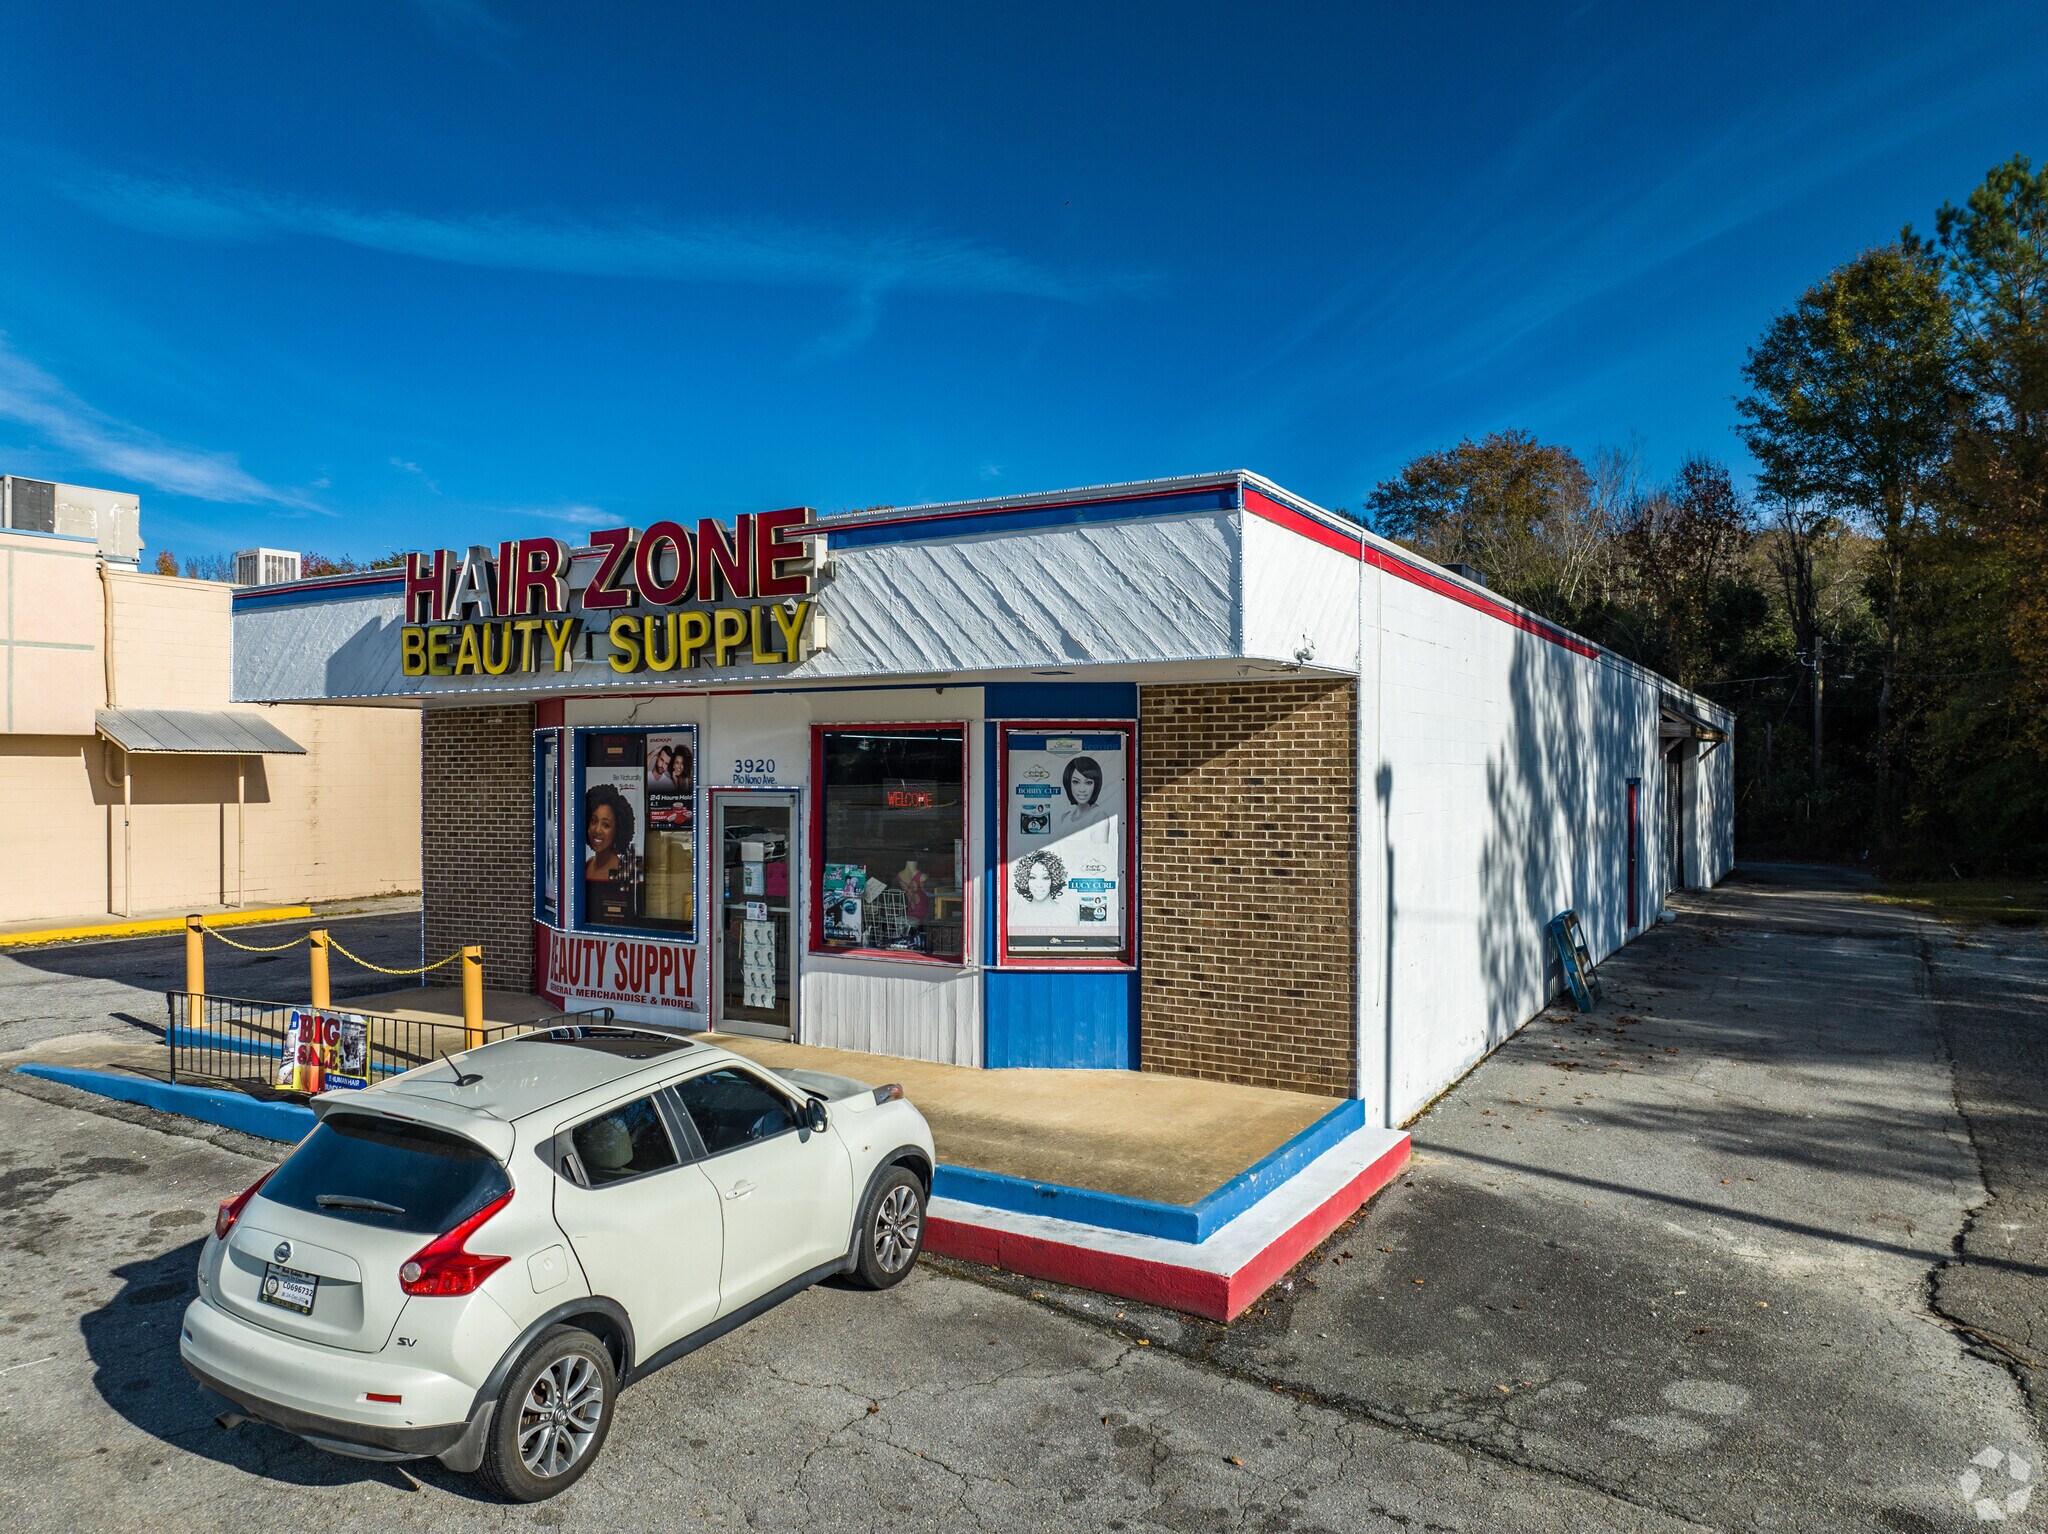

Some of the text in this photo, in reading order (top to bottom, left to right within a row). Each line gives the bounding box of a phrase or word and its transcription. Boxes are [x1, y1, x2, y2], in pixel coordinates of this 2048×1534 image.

[404, 506, 815, 623] HAIR ZONE
[402, 601, 813, 677] BEAUTY SUPPLY
[734, 759, 776, 774] 3920
[620, 774, 642, 782] Naturally
[733, 774, 778, 785] Pio Nono Ave.
[887, 791, 933, 808] WELCOME
[614, 941, 697, 998] SUPPLY
[575, 988, 647, 1004] MERCHANDISE
[650, 996, 658, 1004] &
[661, 997, 694, 1010] MORE!
[298, 1014, 341, 1047] BIG
[332, 1075, 348, 1085] HUMAN
[347, 1078, 360, 1087] HAIR
[396, 1336, 418, 1347] SV
